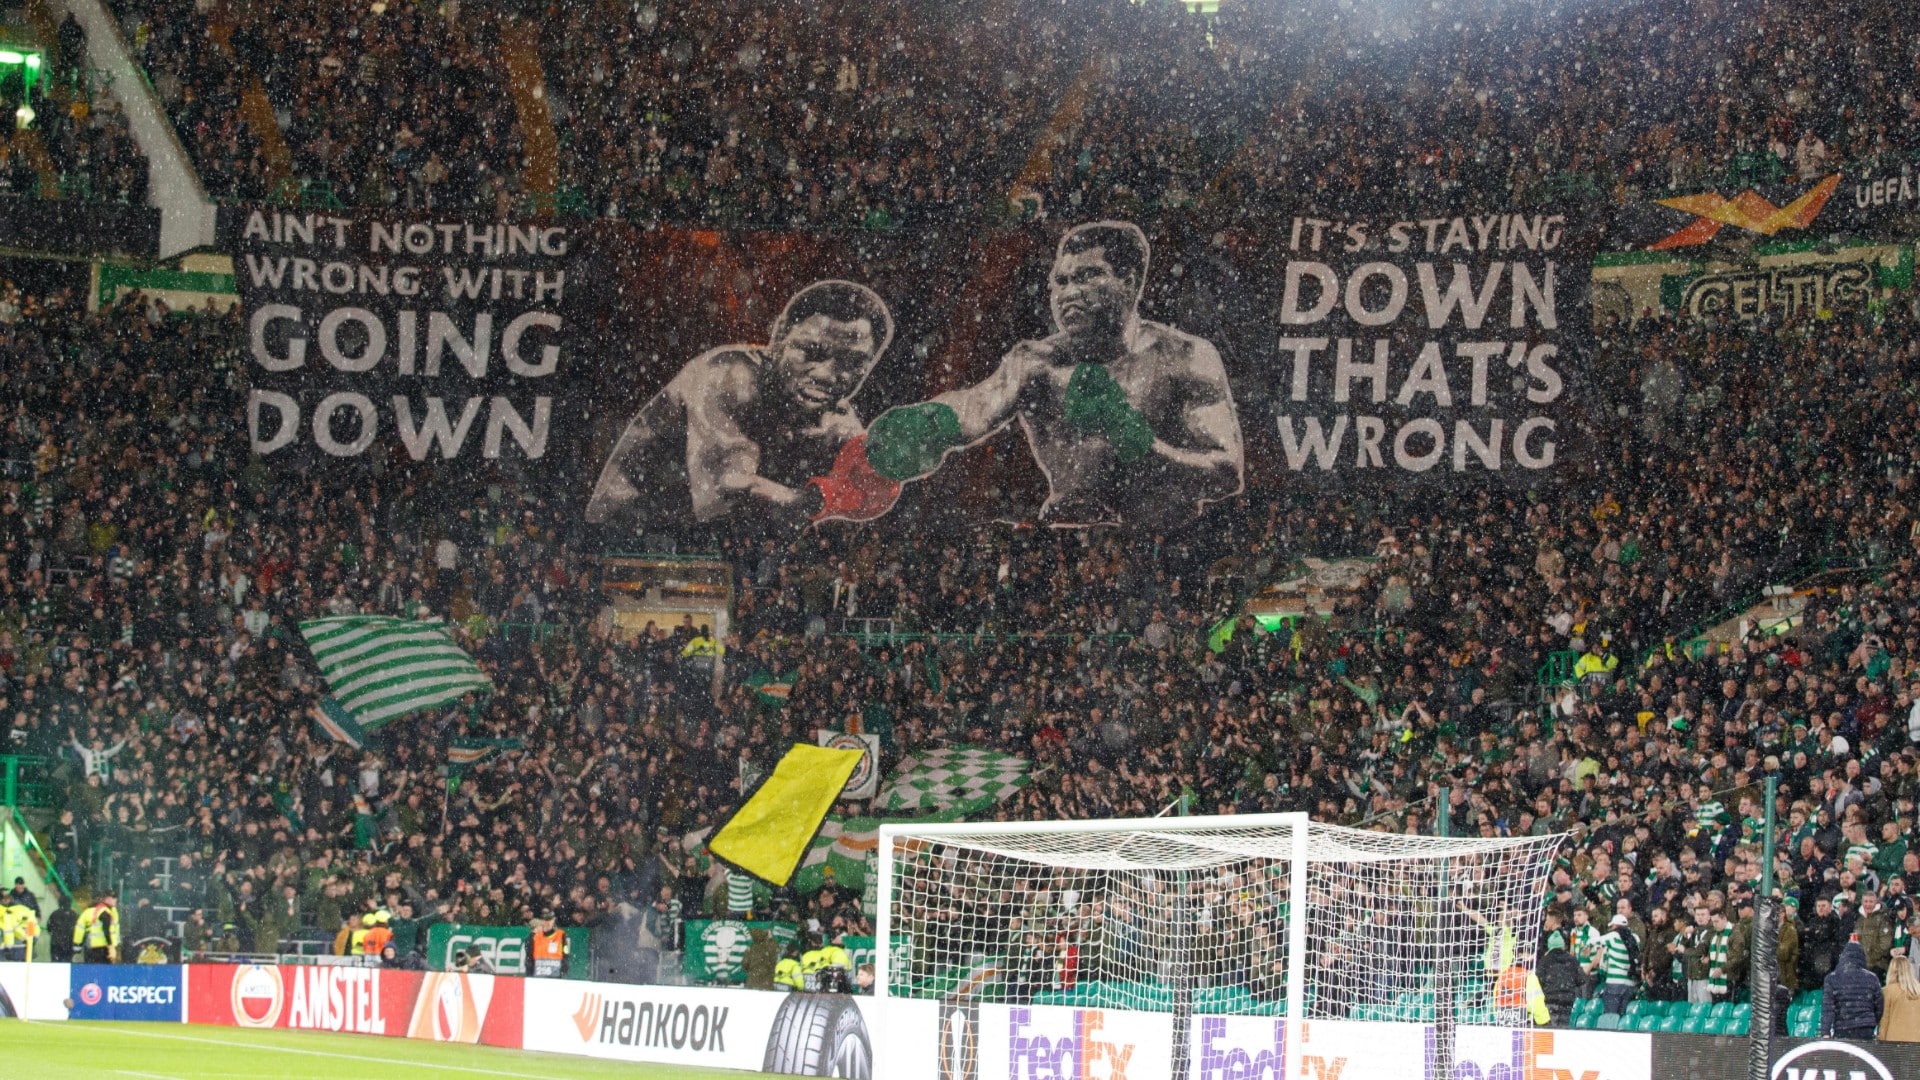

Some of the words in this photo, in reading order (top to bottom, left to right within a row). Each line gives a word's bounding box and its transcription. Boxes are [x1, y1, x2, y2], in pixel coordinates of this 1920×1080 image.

[1856, 176, 1912, 208] UEFA
[243, 210, 352, 248] AIN'T
[371, 221, 567, 256] NOTHING
[1290, 217, 1369, 251] IT'S
[1388, 213, 1564, 253] STAYING
[246, 254, 420, 295] WRONG
[443, 267, 565, 300] WITH
[1280, 261, 1557, 329] DOWN
[1680, 268, 1871, 322] CELTIC
[250, 304, 562, 378] GOING
[1279, 337, 1562, 406] THAT'S
[248, 389, 552, 460] DOWN
[1277, 415, 1556, 472] WRONG
[108, 986, 176, 1004] RESPECT
[289, 965, 385, 1034] AMSTEL
[1008, 1007, 1135, 1080] FedEx
